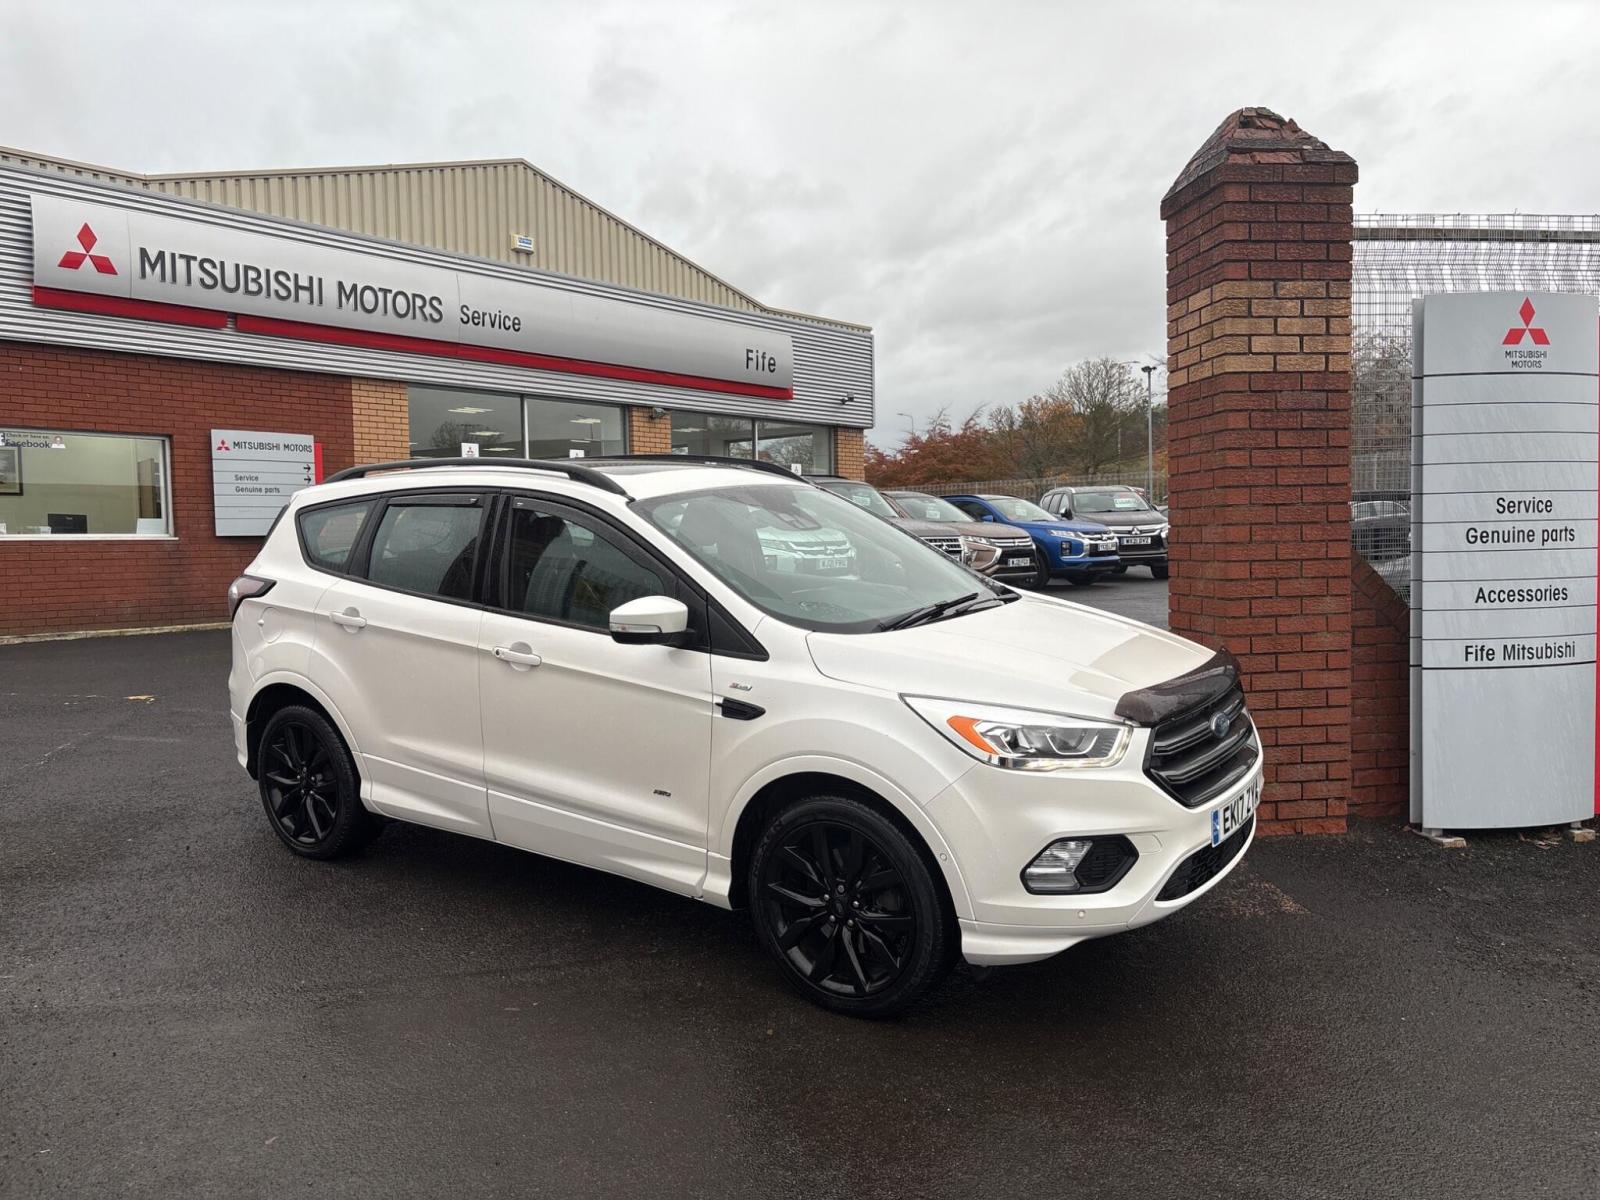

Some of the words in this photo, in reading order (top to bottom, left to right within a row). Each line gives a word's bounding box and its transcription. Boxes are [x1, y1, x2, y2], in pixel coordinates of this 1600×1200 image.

[139, 247, 325, 306] MITSUBISHI
[337, 280, 444, 324] MOTORS
[460, 304, 521, 333] Service
[745, 348, 776, 373] Fife
[1504, 350, 1548, 359] MITSUBISHI
[1511, 360, 1542, 369] MOTORS
[233, 441, 281, 451] MITSUBISHI
[283, 443, 312, 453] MOTORS
[234, 474, 259, 482] Service
[264, 486, 280, 494] parts
[1496, 496, 1553, 515] Service
[1466, 526, 1535, 544] Genuine
[1541, 525, 1575, 546] parts
[1475, 584, 1568, 604] Accessories
[1464, 645, 1496, 662] Fife
[1503, 641, 1575, 661] Mitsubishi
[1223, 794, 1245, 834] EK17
